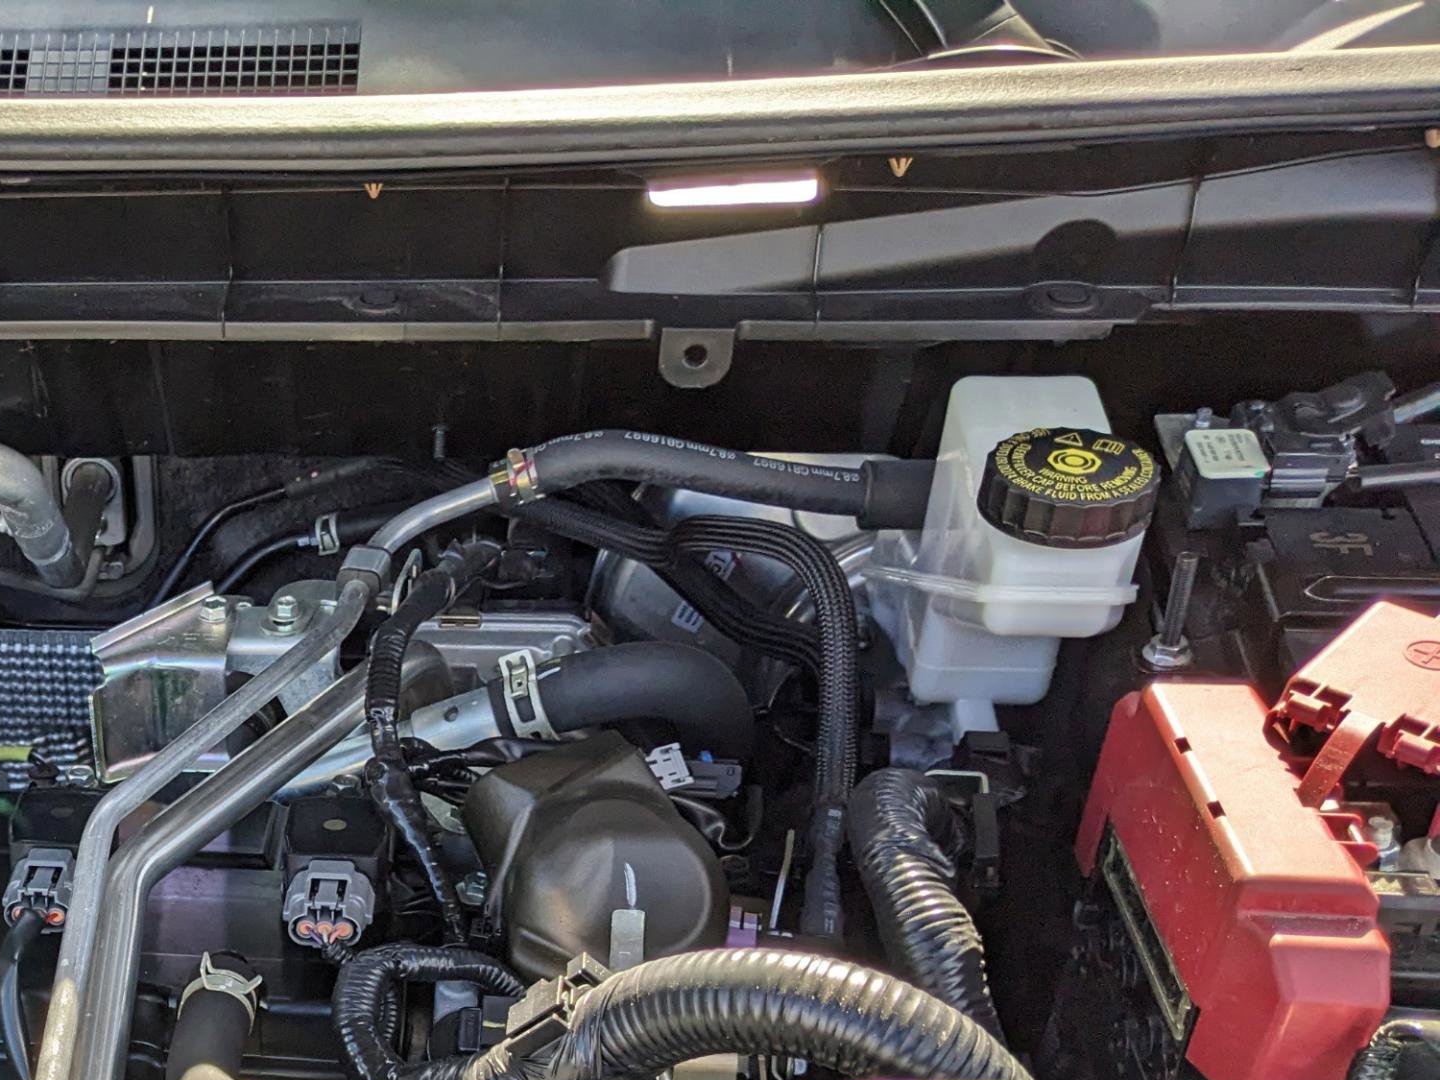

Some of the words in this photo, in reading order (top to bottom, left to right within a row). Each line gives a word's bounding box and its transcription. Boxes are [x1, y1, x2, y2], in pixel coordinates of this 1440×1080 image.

[1032, 474, 1055, 487] CAP
[1055, 482, 1098, 493] BEFORE
[1099, 465, 1138, 490] REMOVING
[1038, 465, 1088, 484] WARNING
[1012, 477, 1045, 494] BRAKE
[1044, 487, 1077, 501] FLUID
[1080, 491, 1111, 501] FROM
[1111, 490, 1121, 498] A
[1118, 476, 1149, 496] SEALED
